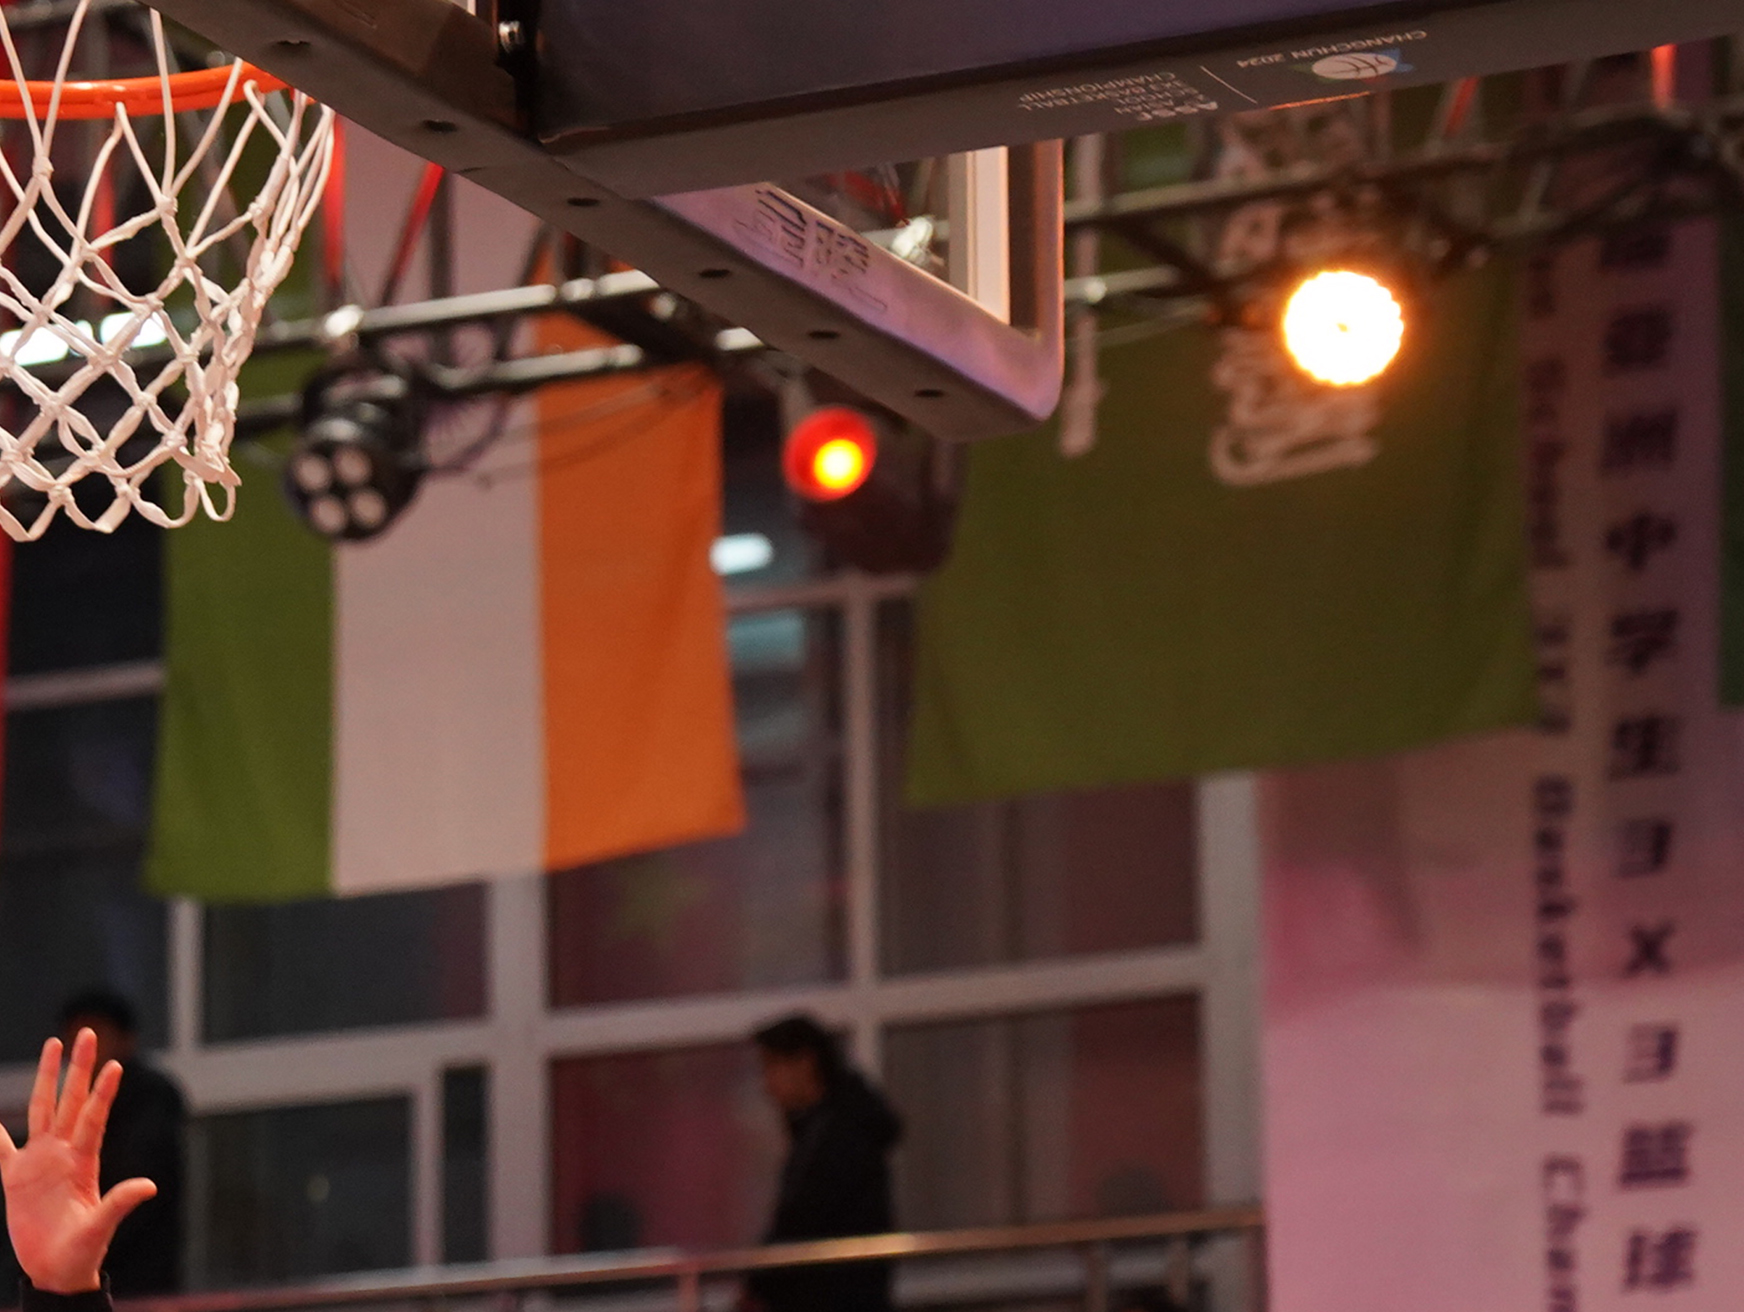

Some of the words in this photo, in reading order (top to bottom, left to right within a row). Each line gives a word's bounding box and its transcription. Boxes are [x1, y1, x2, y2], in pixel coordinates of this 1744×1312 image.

[1290, 30, 1427, 59] CHANGCHUN
[1236, 53, 1286, 68] 2024
[1019, 72, 1176, 103] CHAMPIONSHIP
[1534, 777, 1586, 1114] Basketball
